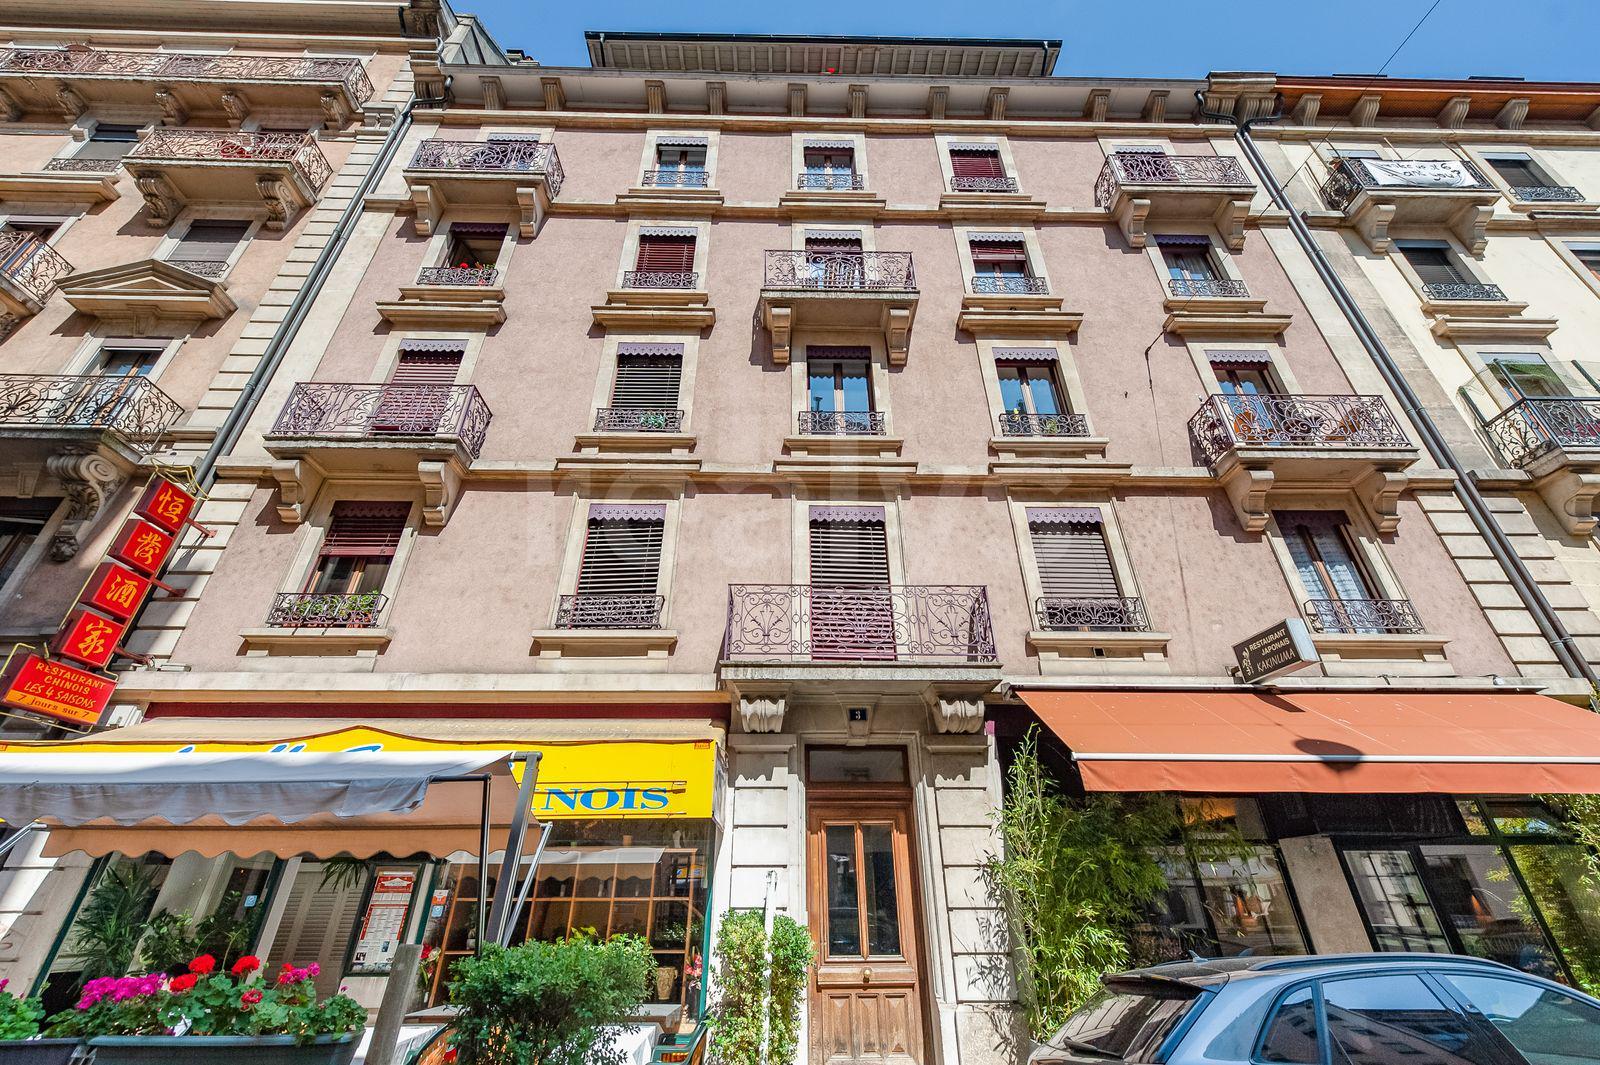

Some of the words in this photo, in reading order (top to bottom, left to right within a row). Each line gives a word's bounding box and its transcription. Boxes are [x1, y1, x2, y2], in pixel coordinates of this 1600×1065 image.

[1249, 628, 1286, 651] RESTAURANT
[1261, 637, 1290, 656] JAPONAIS
[1256, 648, 1296, 672] KAKINUMA
[36, 662, 107, 690] RESTAURANT
[44, 675, 91, 695] CHINOIS
[17, 695, 25, 703] 7
[62, 706, 79, 716] sur
[24, 681, 45, 694] LES
[45, 686, 54, 698] 4
[55, 690, 96, 709] SAISONS
[531, 787, 669, 811] NOIS
